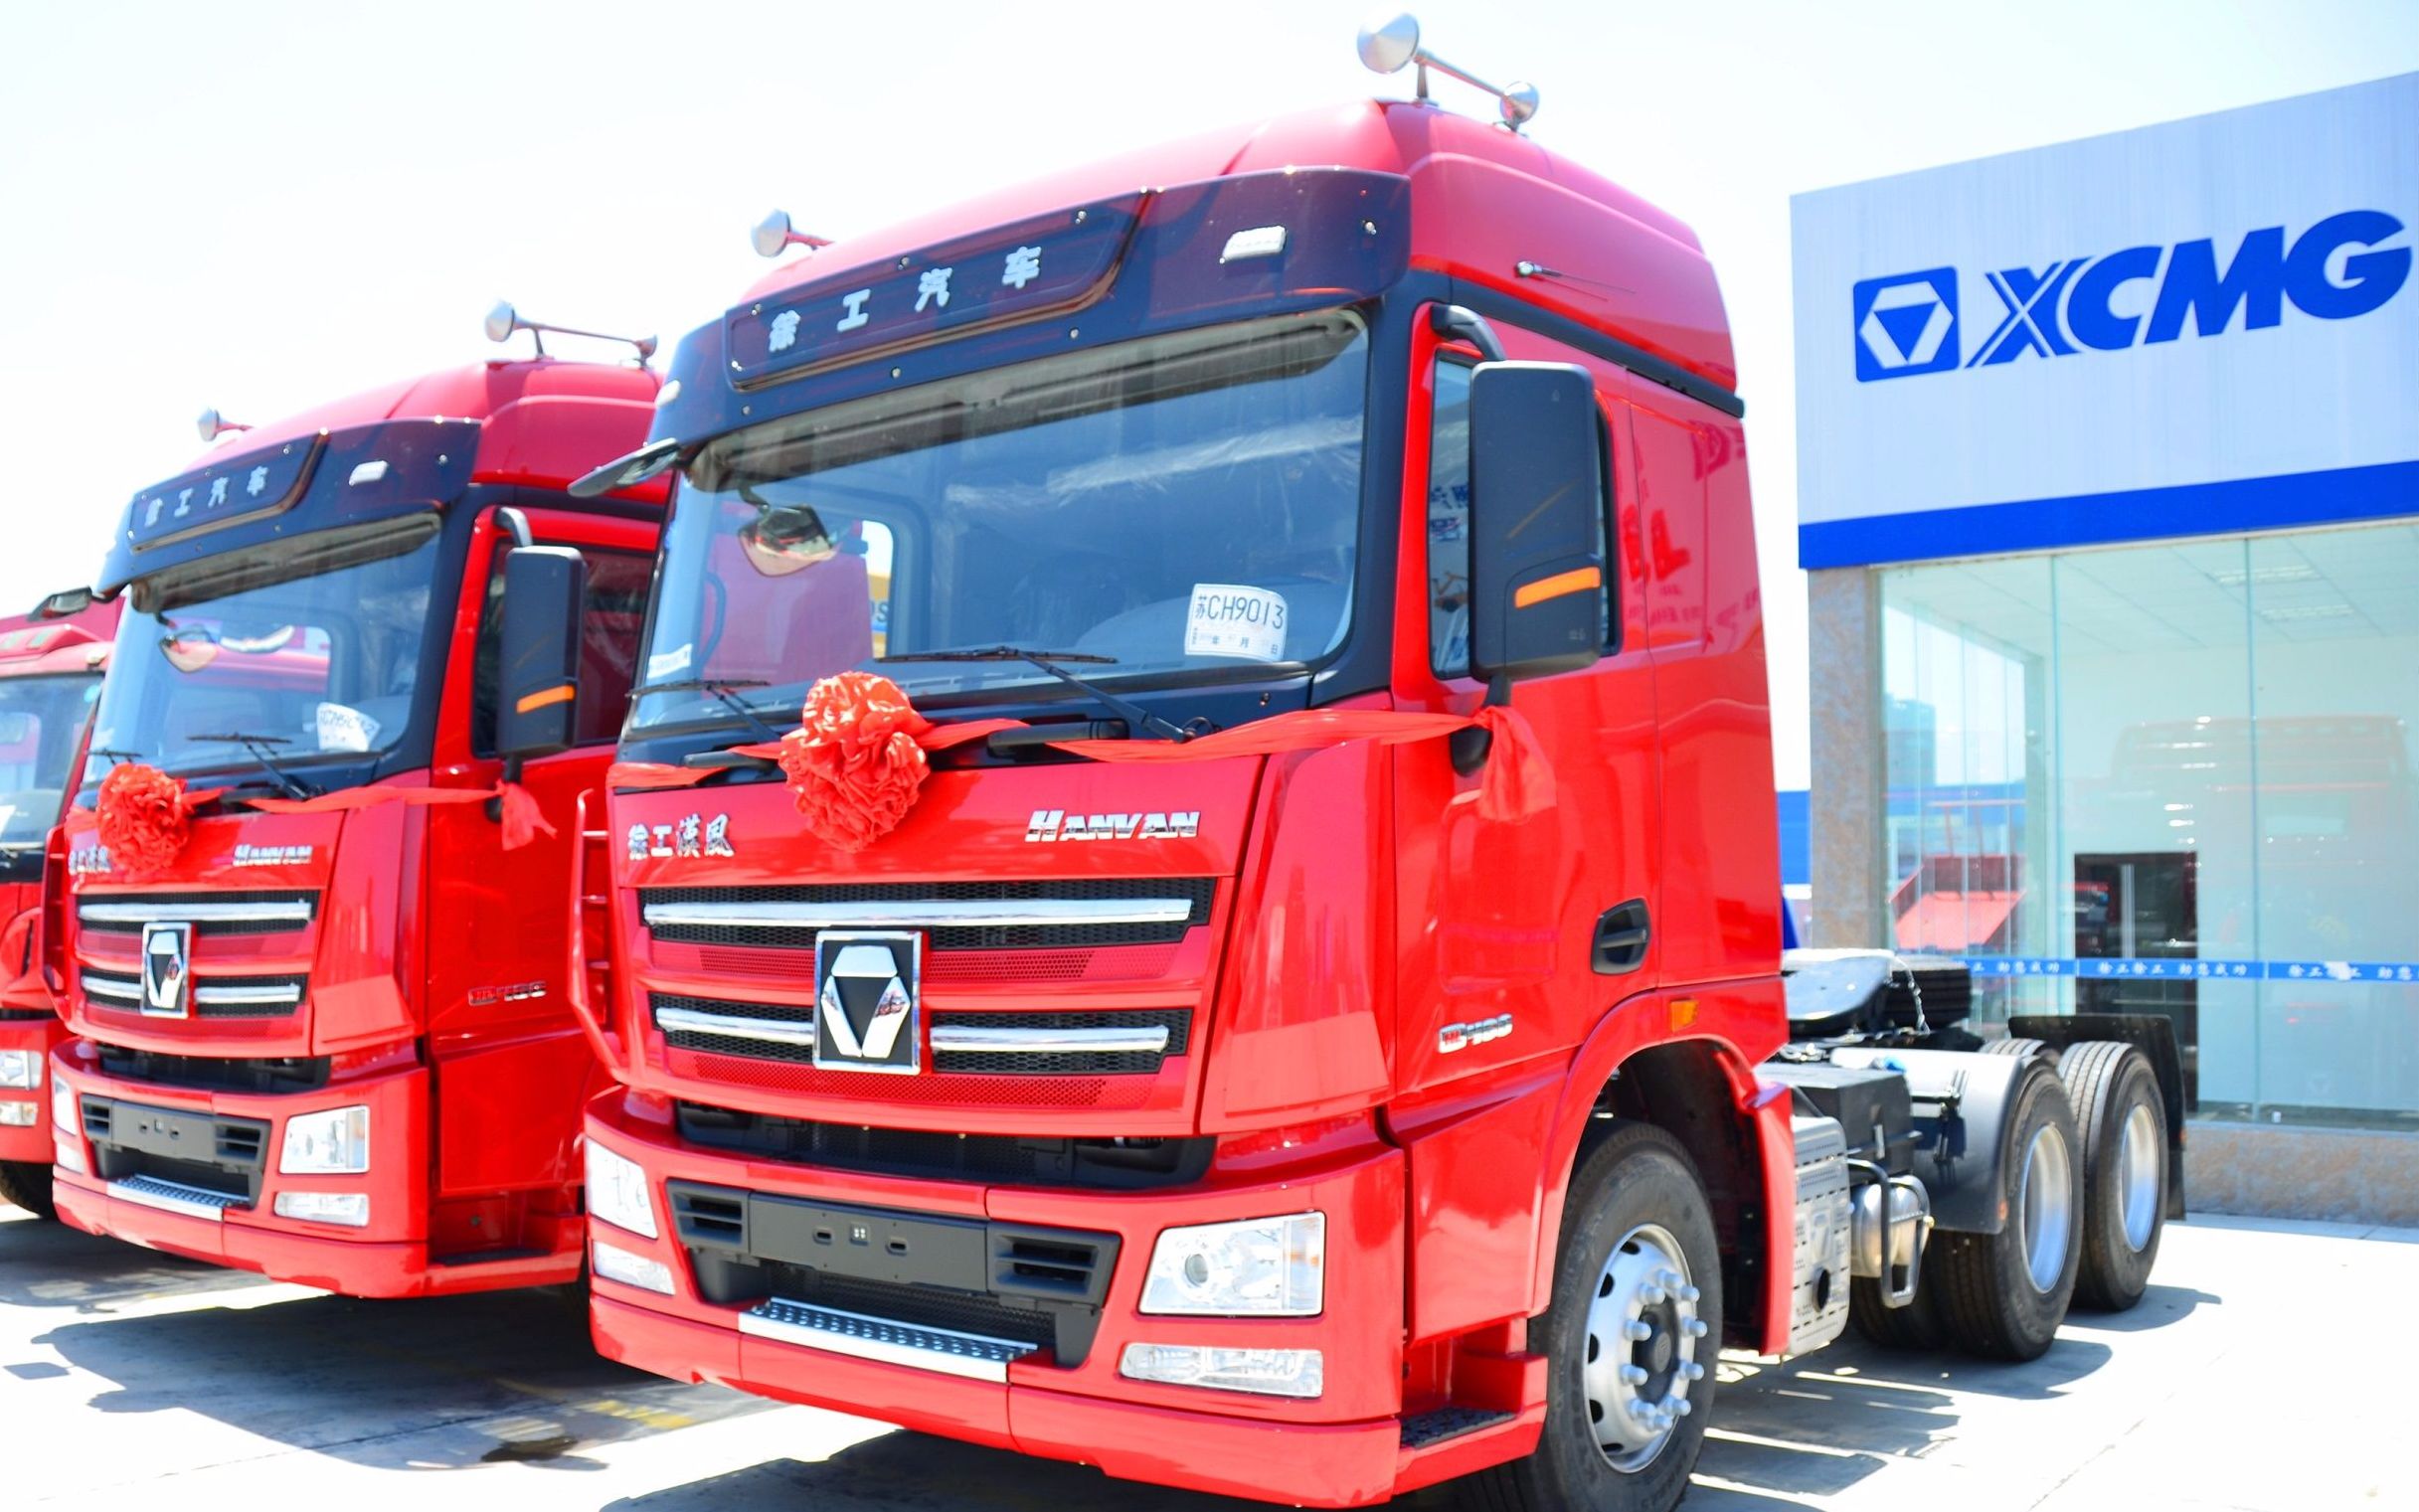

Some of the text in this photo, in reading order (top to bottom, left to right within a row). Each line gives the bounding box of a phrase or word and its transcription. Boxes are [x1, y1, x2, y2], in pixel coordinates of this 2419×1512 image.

[769, 246, 1042, 352] 徐工汽车
[1965, 210, 2412, 368] XCMG
[1195, 593, 1285, 629] 苏CH9013
